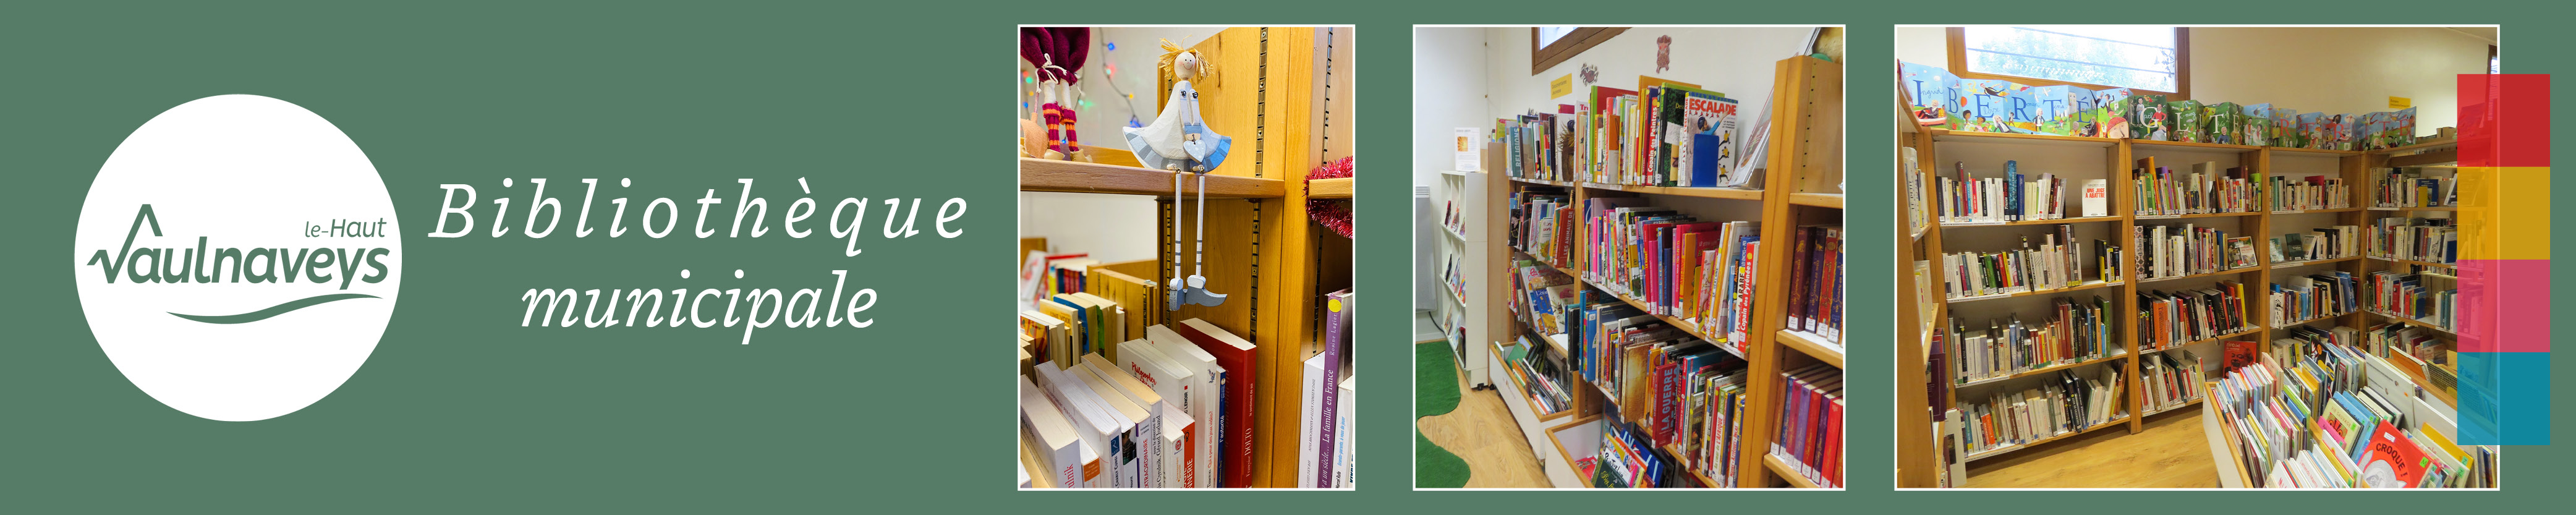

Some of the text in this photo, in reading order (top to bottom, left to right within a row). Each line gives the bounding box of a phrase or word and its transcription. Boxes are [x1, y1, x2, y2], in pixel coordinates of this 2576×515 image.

[1689, 98, 1737, 116] ESCALADE
[1568, 211, 1573, 220] DE
[1743, 262, 1751, 295] Pyrénées
[1740, 308, 1748, 331] Copain
[1325, 369, 1333, 394] France
[1327, 397, 1332, 405] en
[1661, 368, 1673, 431] LA GUERRE
[1323, 407, 1332, 430] famille
[1322, 434, 1330, 443] La
[2376, 443, 2405, 471] CROQUE
[1064, 464, 1074, 488] ulnik
